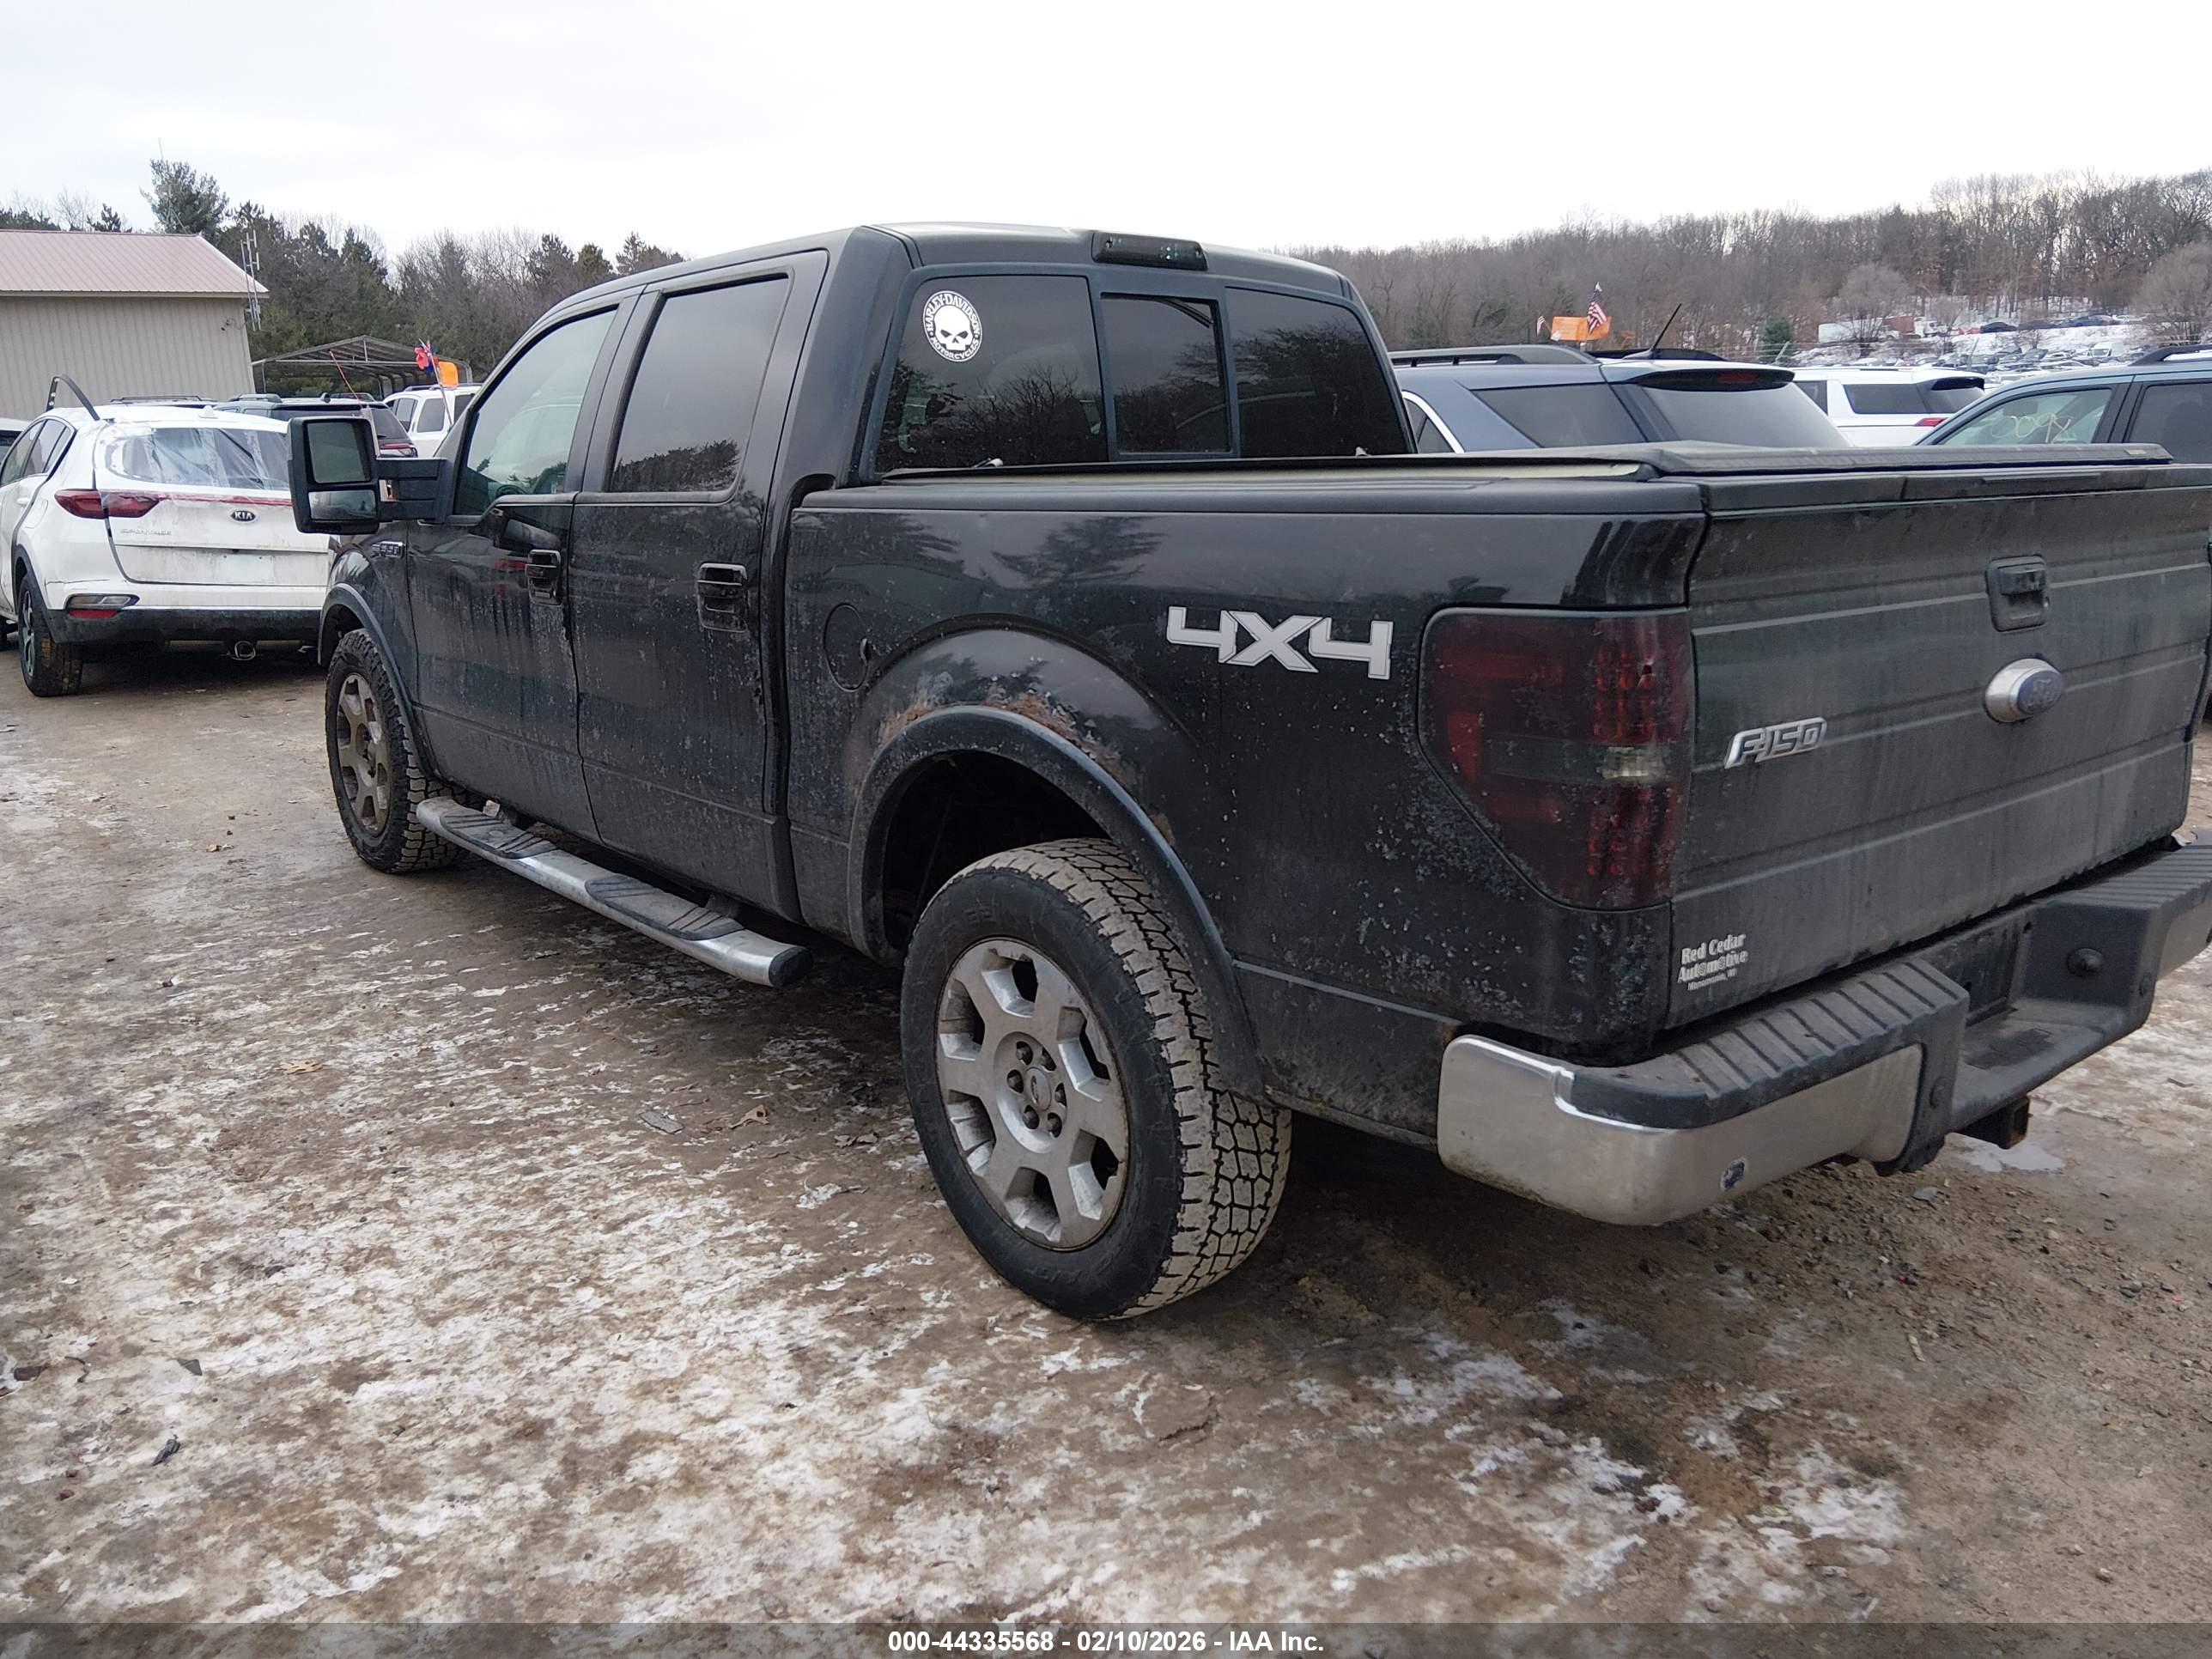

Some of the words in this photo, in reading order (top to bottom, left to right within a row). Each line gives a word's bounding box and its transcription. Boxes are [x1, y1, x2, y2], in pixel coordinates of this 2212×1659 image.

[925, 293, 981, 336] HARLEY-DAVIDSON
[930, 336, 980, 360] MOTORCYCLES
[234, 510, 253, 521] KIA
[1681, 942, 1707, 965] Red
[1708, 934, 1746, 956] Cedar
[1677, 951, 1748, 983] Automotive
